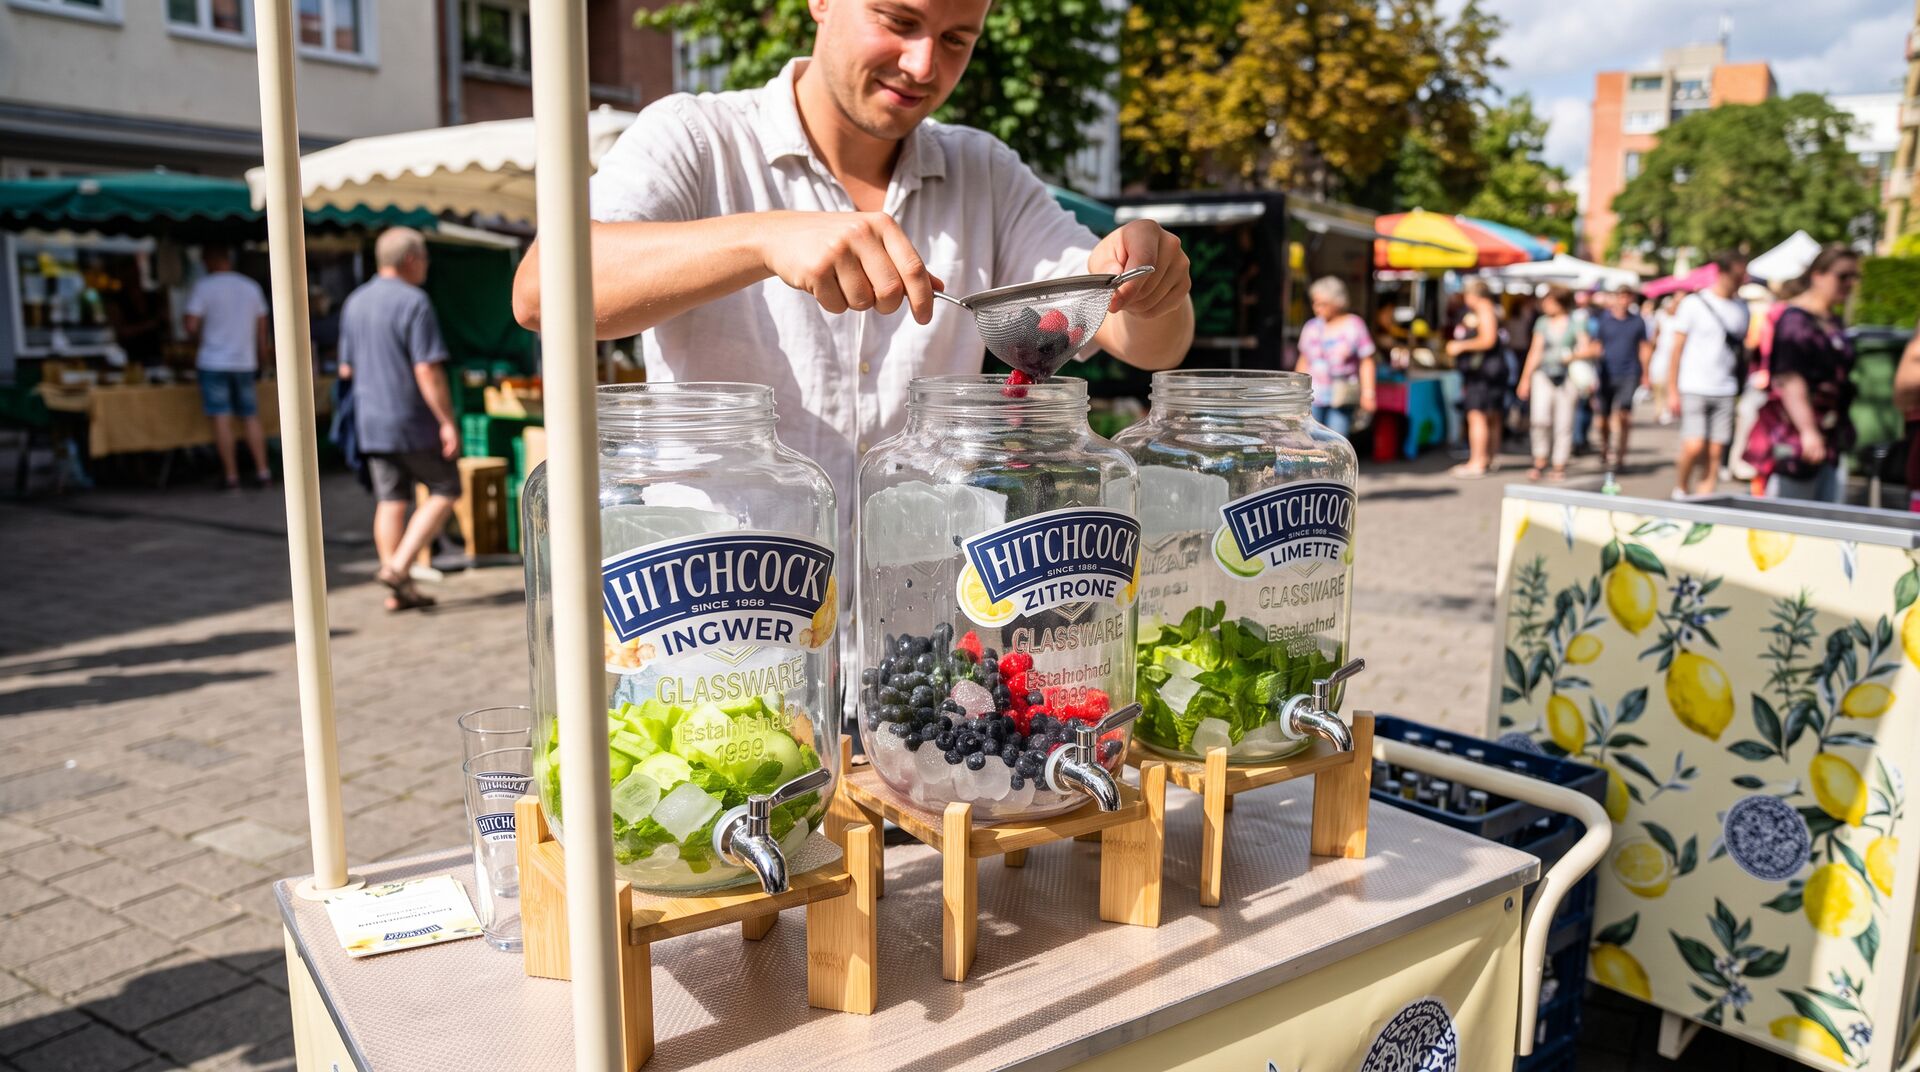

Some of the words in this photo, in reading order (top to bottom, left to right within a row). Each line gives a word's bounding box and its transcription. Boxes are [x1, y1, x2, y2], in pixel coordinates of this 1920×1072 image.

[1239, 494, 1355, 544] HITCHCOCK
[1288, 529, 1310, 539] SINCE
[985, 523, 1139, 585] HITCHCOCK
[1047, 565, 1074, 577] SINCE
[1270, 541, 1340, 567] LIMETTE
[608, 549, 826, 623] HITCHCOCK
[1022, 579, 1118, 612] ZITRONE
[691, 600, 730, 613] SINCE
[661, 617, 794, 656] INGWER
[1012, 612, 1125, 655] GLASSWARE
[656, 656, 808, 706] GLASSWARE
[478, 815, 516, 833] HITCHC
